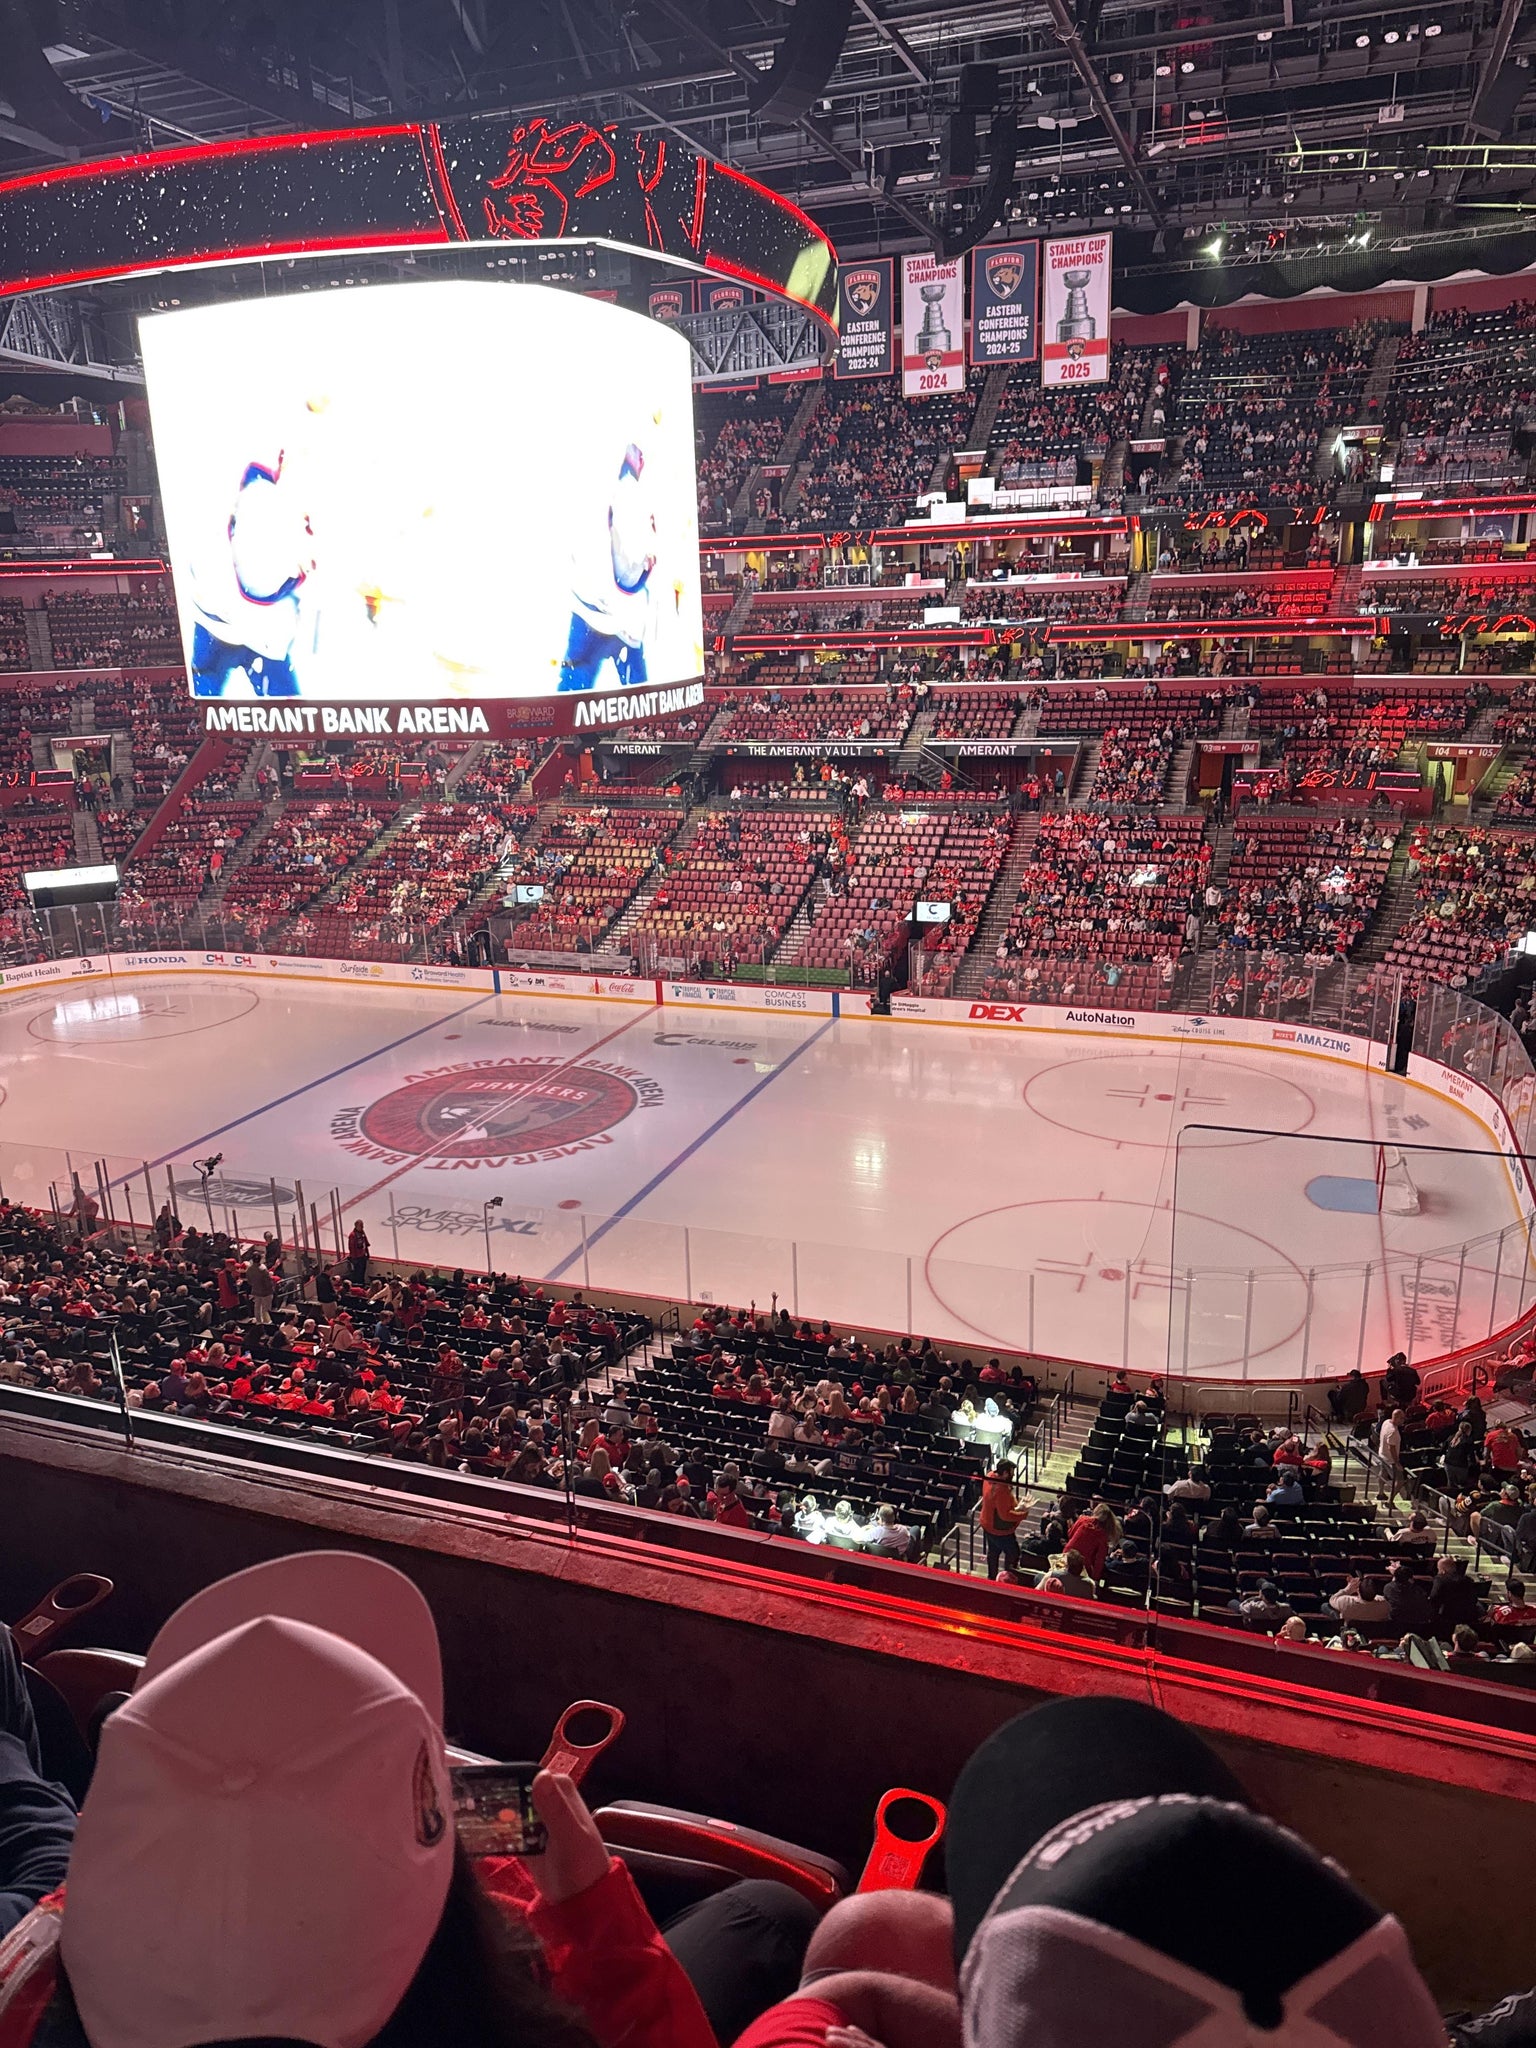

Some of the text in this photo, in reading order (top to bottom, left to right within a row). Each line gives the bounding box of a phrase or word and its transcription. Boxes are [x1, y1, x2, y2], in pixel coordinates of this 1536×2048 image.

[1049, 239, 1107, 257] STANLEY CUP
[906, 256, 939, 273] STANLE
[1051, 252, 1104, 269] CHAMPIONS
[909, 268, 957, 284] CHAMPIONS
[986, 304, 1022, 317] EASTERN
[847, 320, 880, 333] EASTERN
[978, 316, 1029, 331] CONFERENCE
[840, 332, 886, 346] CONFERENCE
[980, 329, 1028, 343] CHAMPIONS
[842, 344, 885, 358] CHAMPIONS
[986, 342, 1021, 355] 2024-25
[848, 357, 879, 370] 2023-24
[1060, 362, 1091, 380] 2025
[920, 373, 947, 390] 2024
[574, 692, 659, 728] AMERANT
[659, 685, 686, 715] BANK
[206, 706, 489, 733] AMERANT BANK ARENA
[612, 745, 661, 755] AMERANT
[748, 745, 862, 756] THE AMERANT VAULT
[959, 745, 1017, 756] AMERANT
[1241, 744, 1255, 752] 104
[1435, 747, 1450, 756] 104
[138, 956, 187, 964] HONDA
[206, 954, 224, 963] CH
[234, 955, 252, 964] CH
[6, 970, 33, 982] Baptist
[35, 966, 61, 977] Health
[608, 982, 635, 993] Coca-Cola
[764, 990, 806, 1000] COMCAST
[765, 998, 807, 1008] BUSINESS
[968, 1004, 1027, 1022] DEX
[1066, 1010, 1135, 1026] AutoNation
[478, 1018, 581, 1034] AutoNation
[686, 1038, 758, 1050] CELSIUS
[1296, 1033, 1351, 1053] AMAZING
[403, 1056, 665, 1108] AMERANT BANK ARENA
[1441, 1069, 1474, 1093] AMERANT
[466, 1081, 588, 1101] PANTHERS
[1448, 1084, 1465, 1100] BANK
[330, 1105, 614, 1170] AMERANT BANK ARENA
[187, 1182, 273, 1202] Ford
[397, 1206, 495, 1226] OMEGA
[381, 1215, 481, 1236] SPORT
